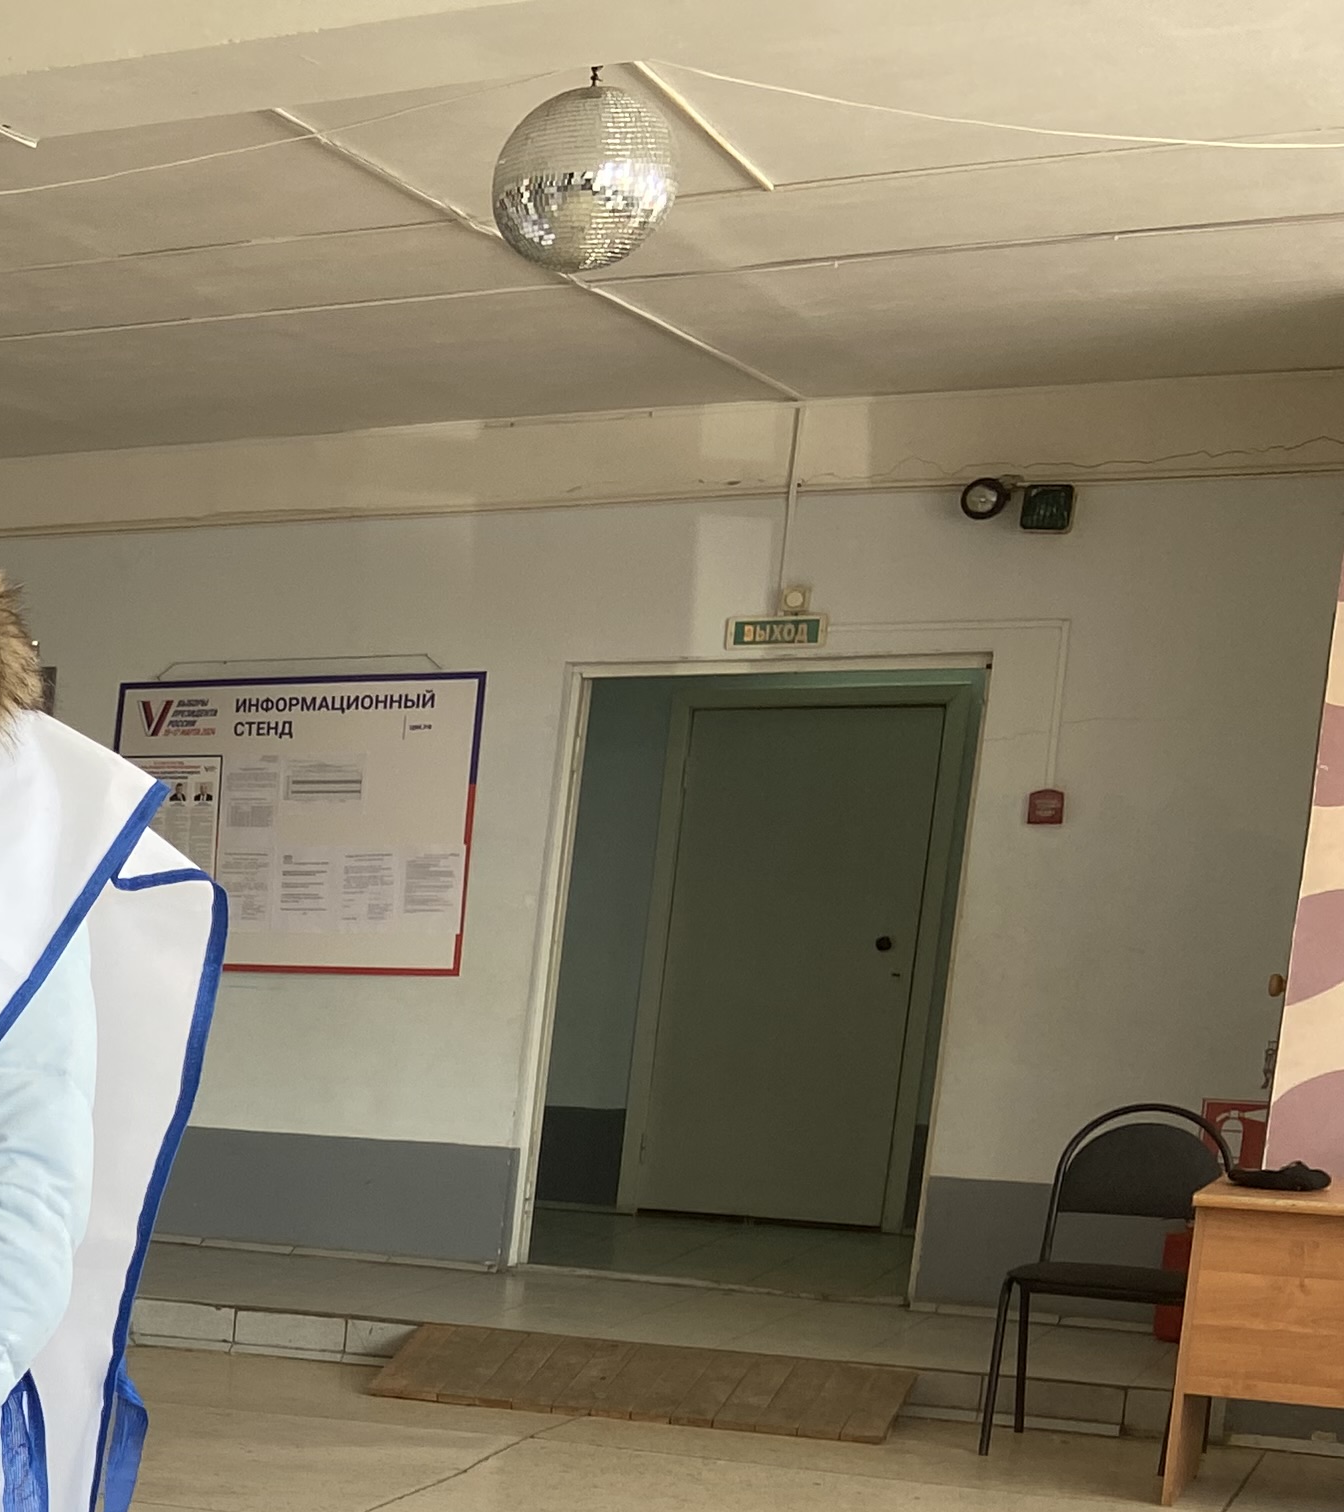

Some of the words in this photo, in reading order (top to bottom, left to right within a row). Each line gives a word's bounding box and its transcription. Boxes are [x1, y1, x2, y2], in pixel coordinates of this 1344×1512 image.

[743, 623, 808, 644] ВЫХОД
[235, 689, 436, 714] ИНФОРМАЦИОННЫЙ
[233, 720, 293, 739] СТЕНД
